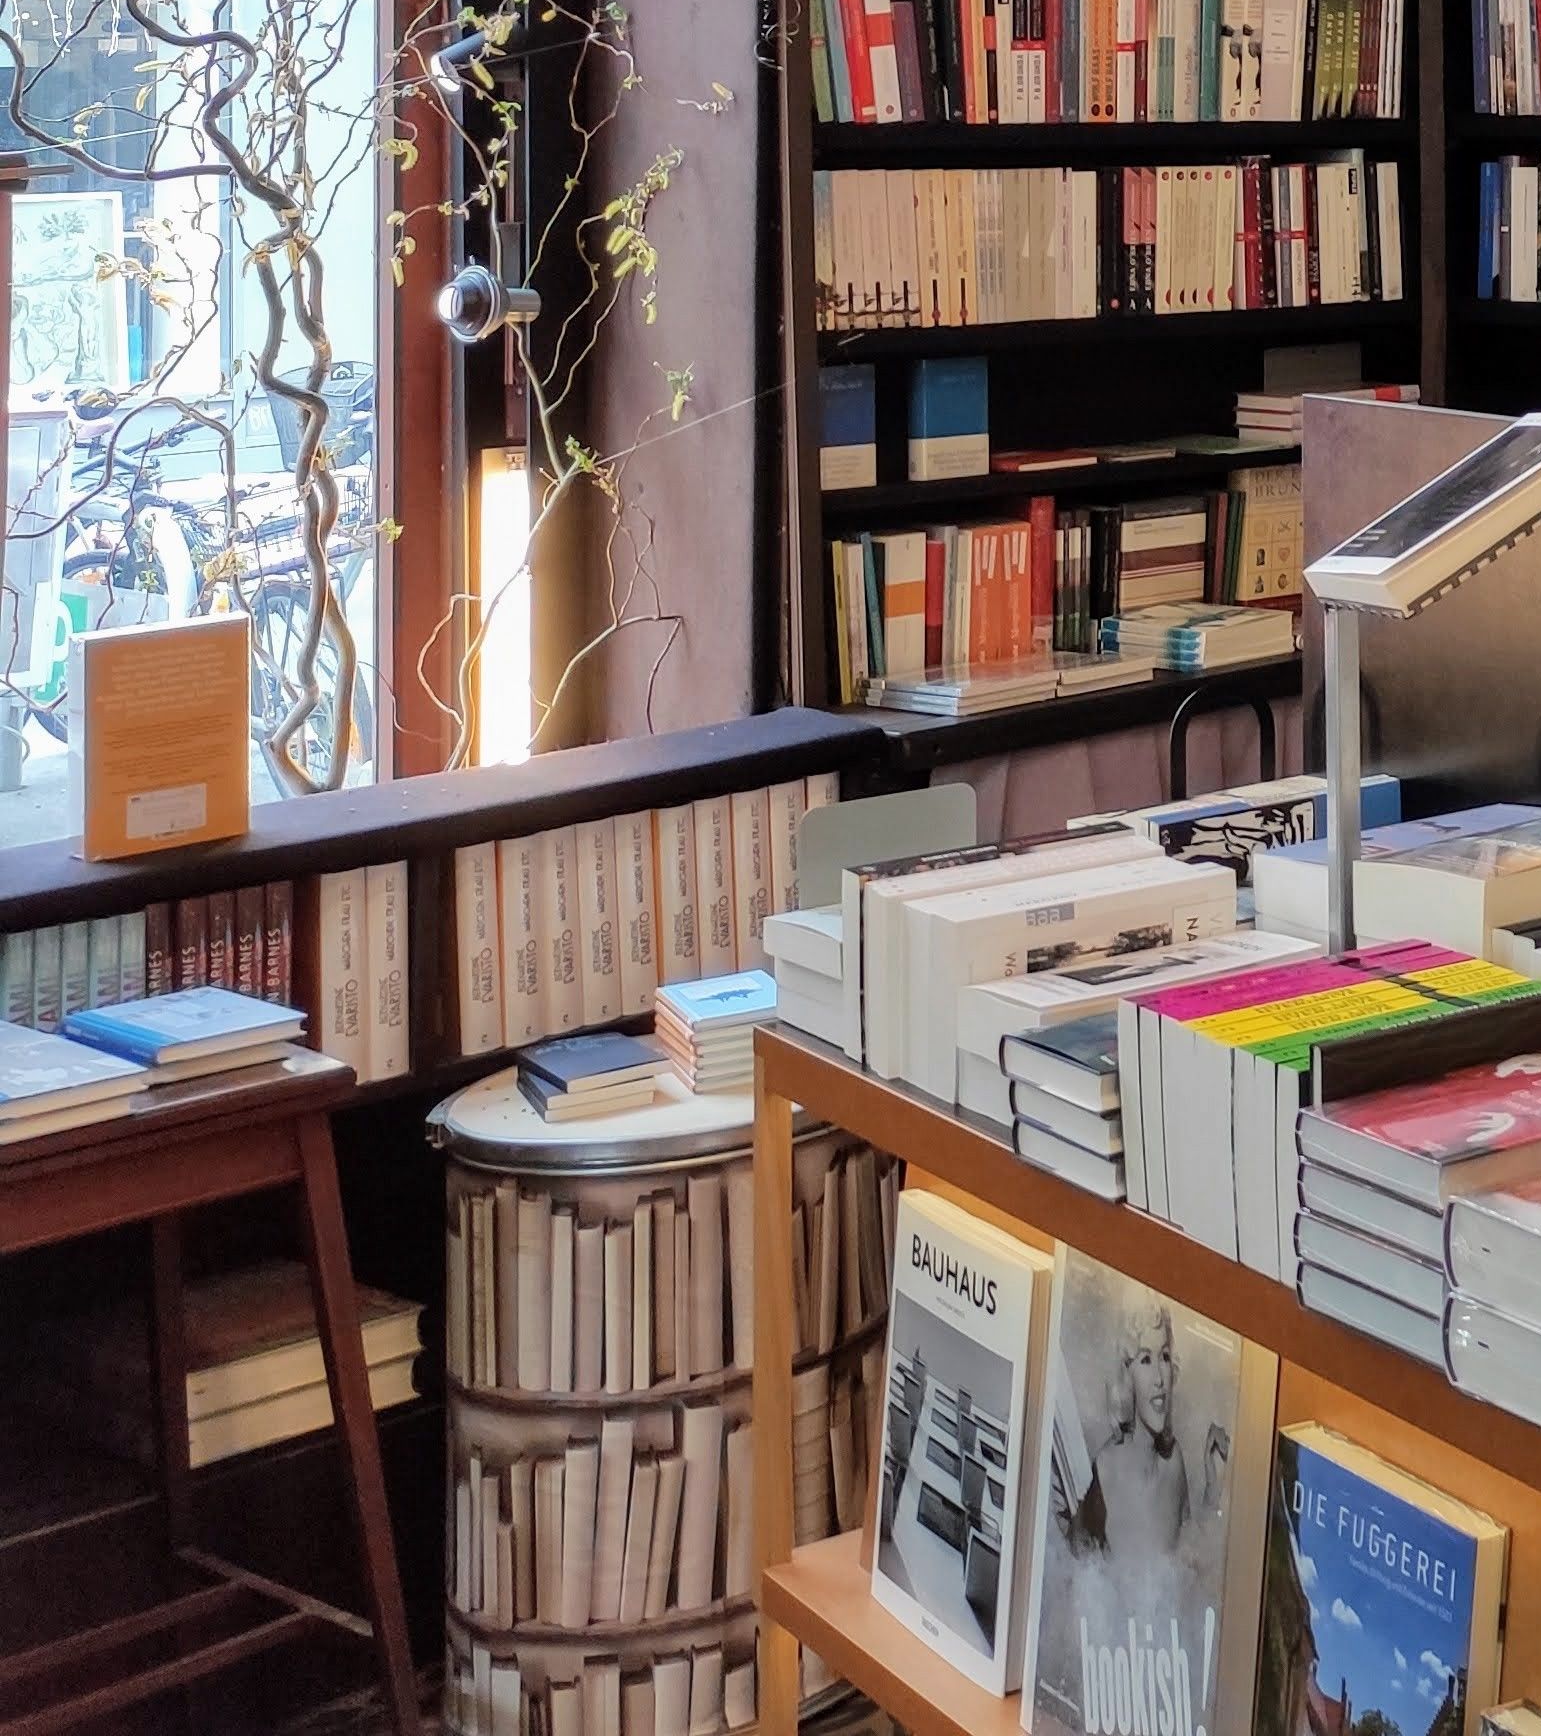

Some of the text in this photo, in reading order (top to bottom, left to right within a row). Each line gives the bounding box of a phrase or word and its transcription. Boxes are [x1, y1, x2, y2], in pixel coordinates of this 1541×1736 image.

[239, 933, 254, 992] BARNES
[266, 926, 283, 977] BARNES
[344, 977, 361, 1038] EVARISTO
[388, 969, 404, 1029] EVARISTO
[910, 1231, 1001, 1320] BAUHAUS
[1292, 1480, 1329, 1535] DIE
[1336, 1496, 1459, 1605] FUGGEREI
